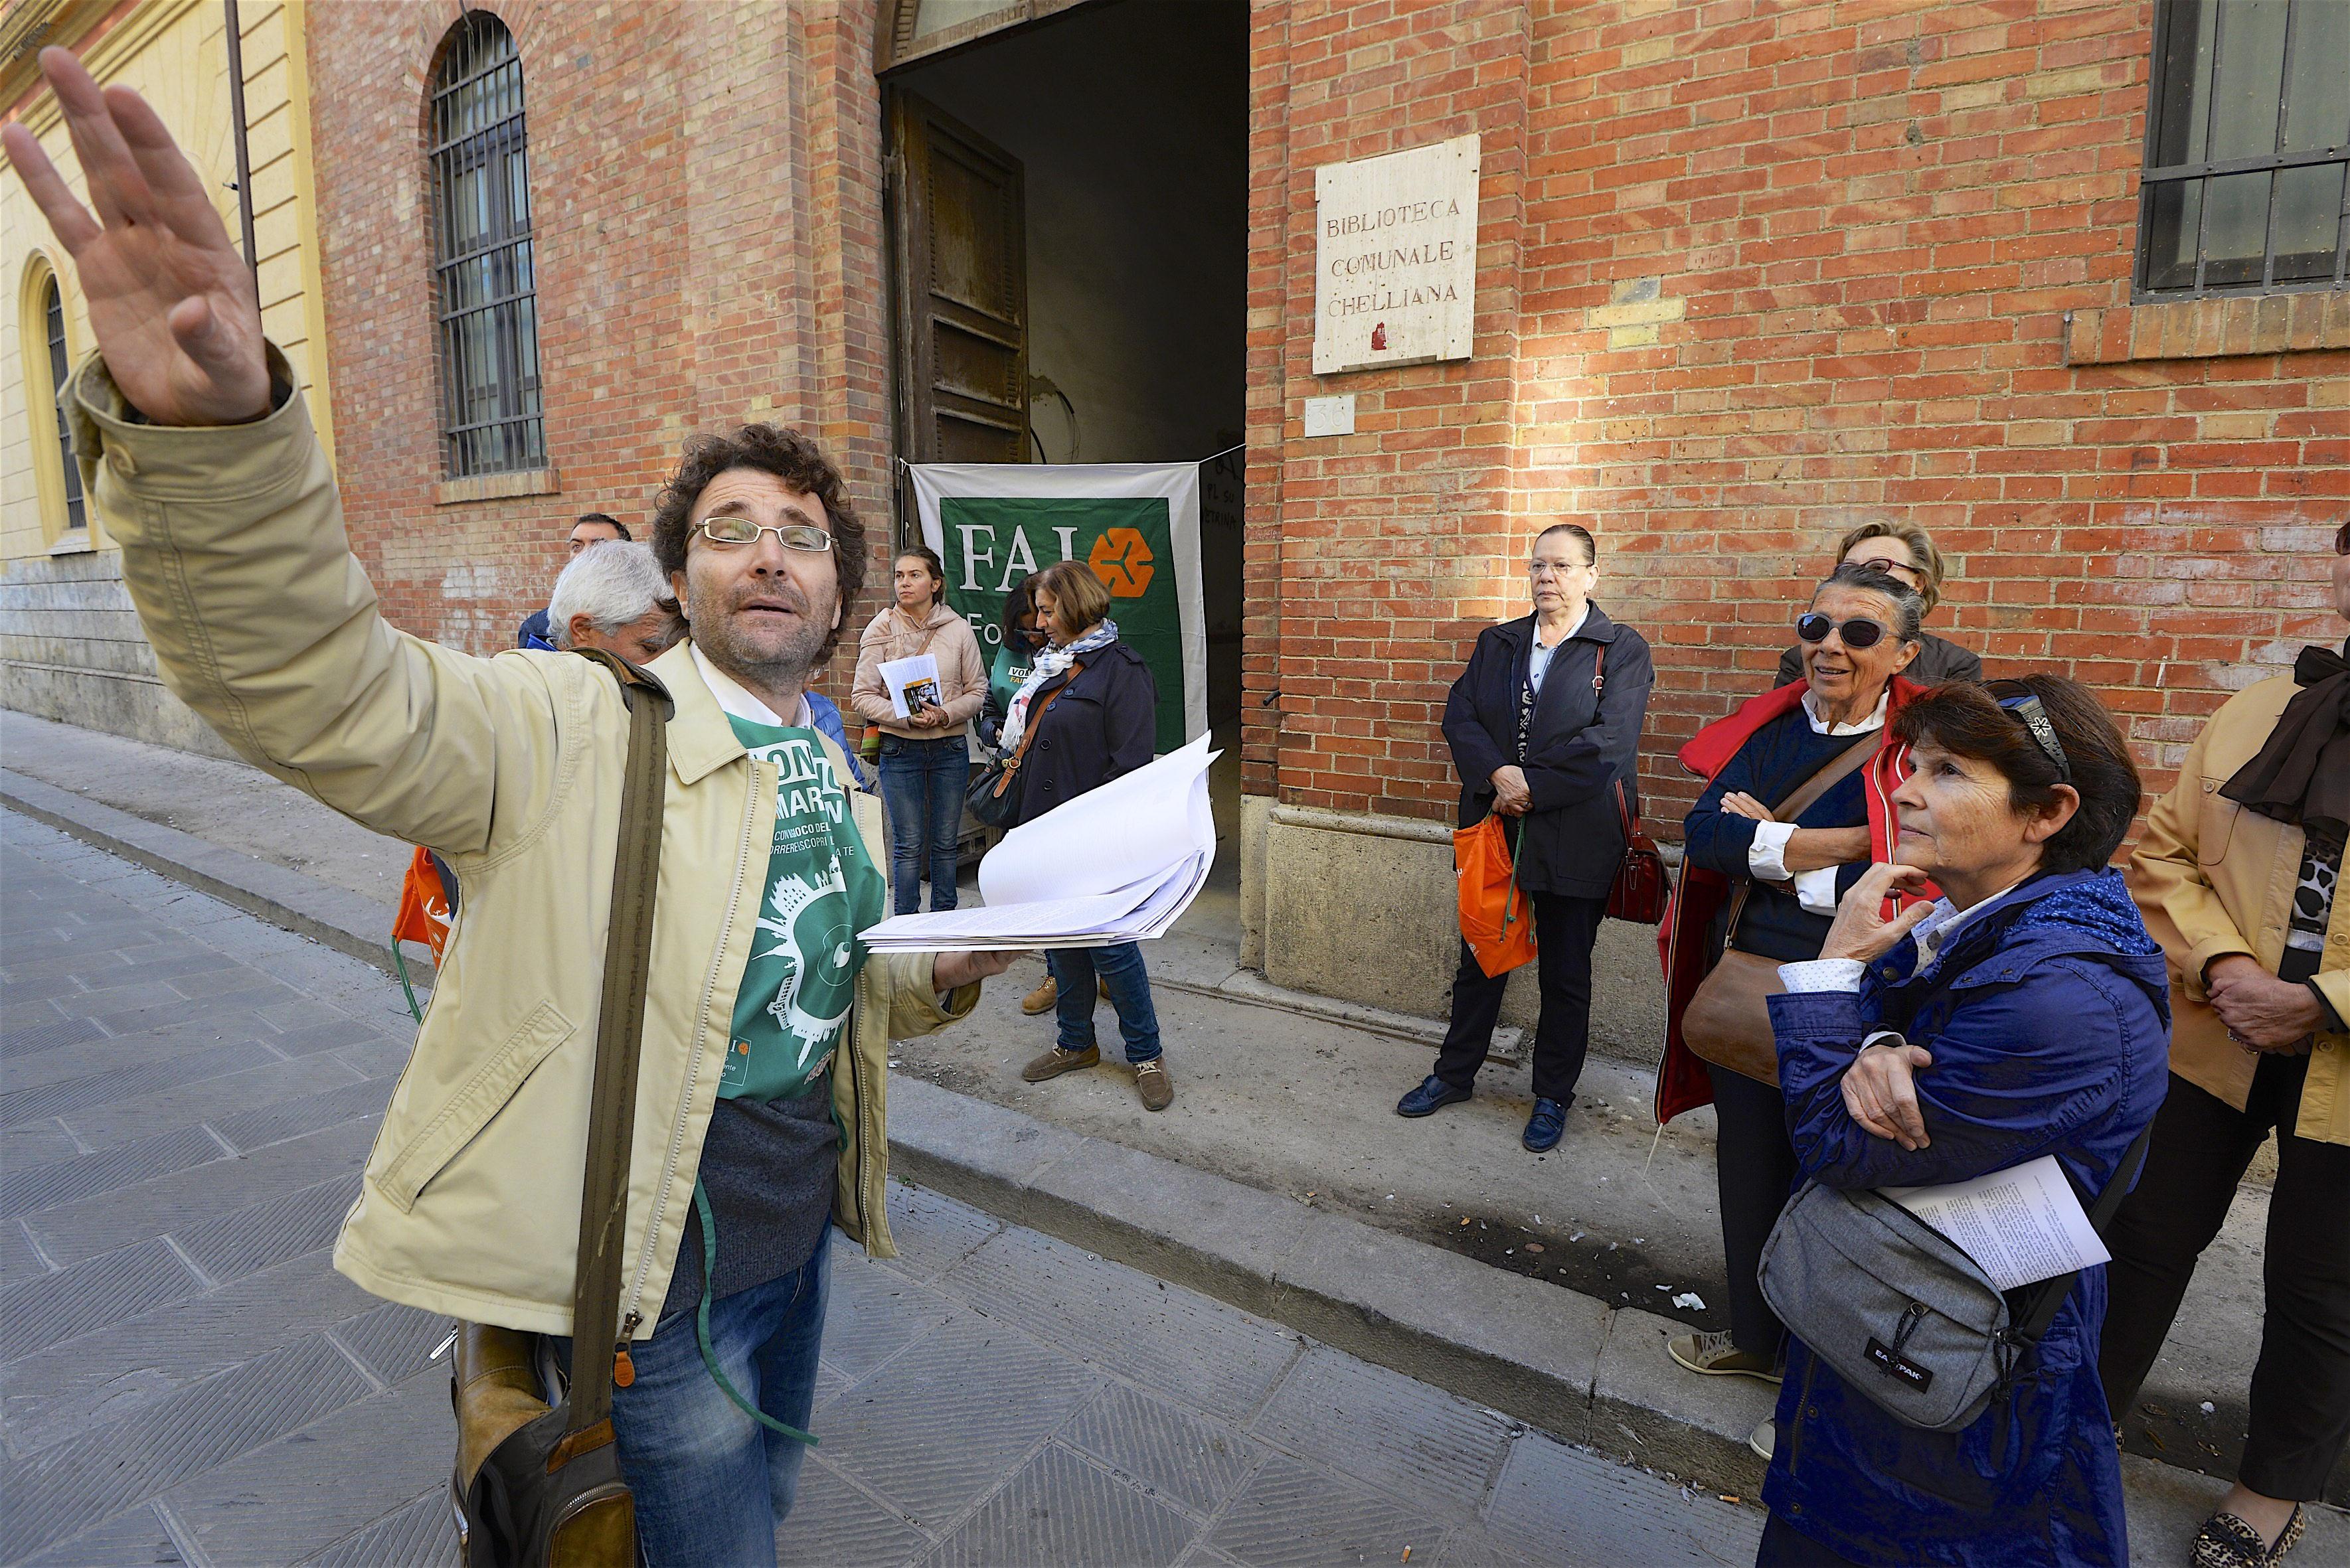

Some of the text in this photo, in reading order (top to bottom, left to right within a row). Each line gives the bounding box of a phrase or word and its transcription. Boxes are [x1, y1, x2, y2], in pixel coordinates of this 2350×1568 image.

[1327, 198, 1460, 238] BIBLIOTECA
[1331, 240, 1454, 277] COMUNALE
[1328, 283, 1458, 317] CHELLIANA
[955, 524, 1078, 592] FAI
[843, 846, 855, 856] TE
[1875, 1349, 1919, 1381] EAPAK
